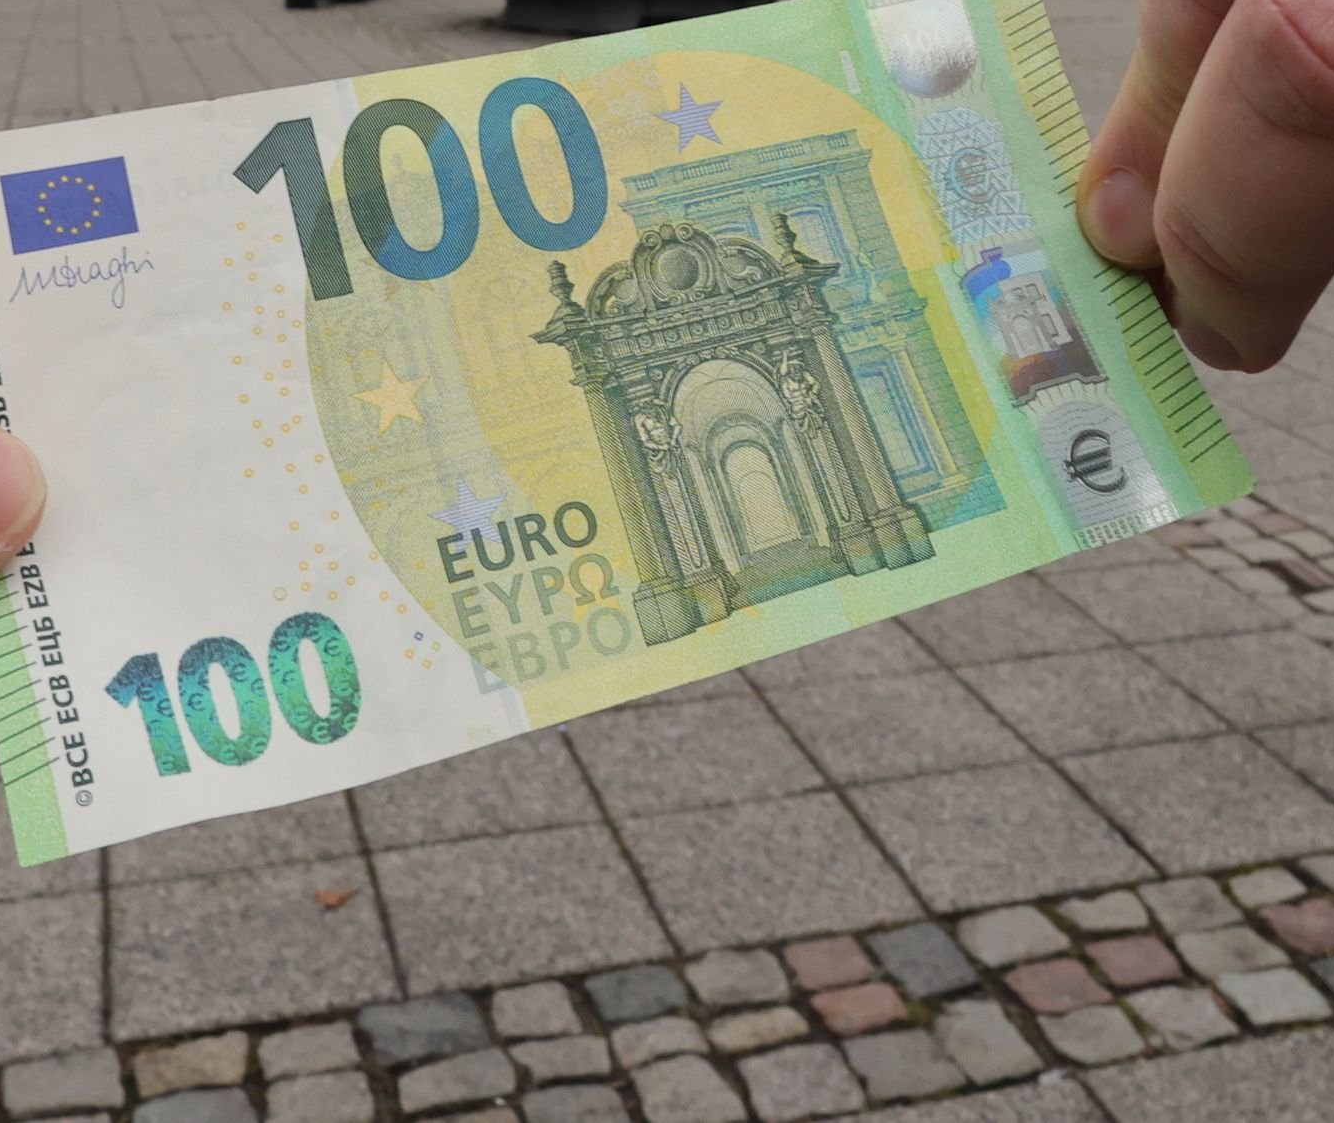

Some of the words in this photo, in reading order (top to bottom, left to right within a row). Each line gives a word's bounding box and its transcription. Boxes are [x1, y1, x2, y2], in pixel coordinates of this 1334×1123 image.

[233, 76, 609, 302] 100
[436, 500, 599, 584] EURO
[19, 563, 50, 610] EZB
[451, 552, 620, 639] ΕΥΡΩ
[104, 610, 363, 777] 100
[468, 605, 633, 695] ЕВРО
[50, 674, 80, 724] ECB
